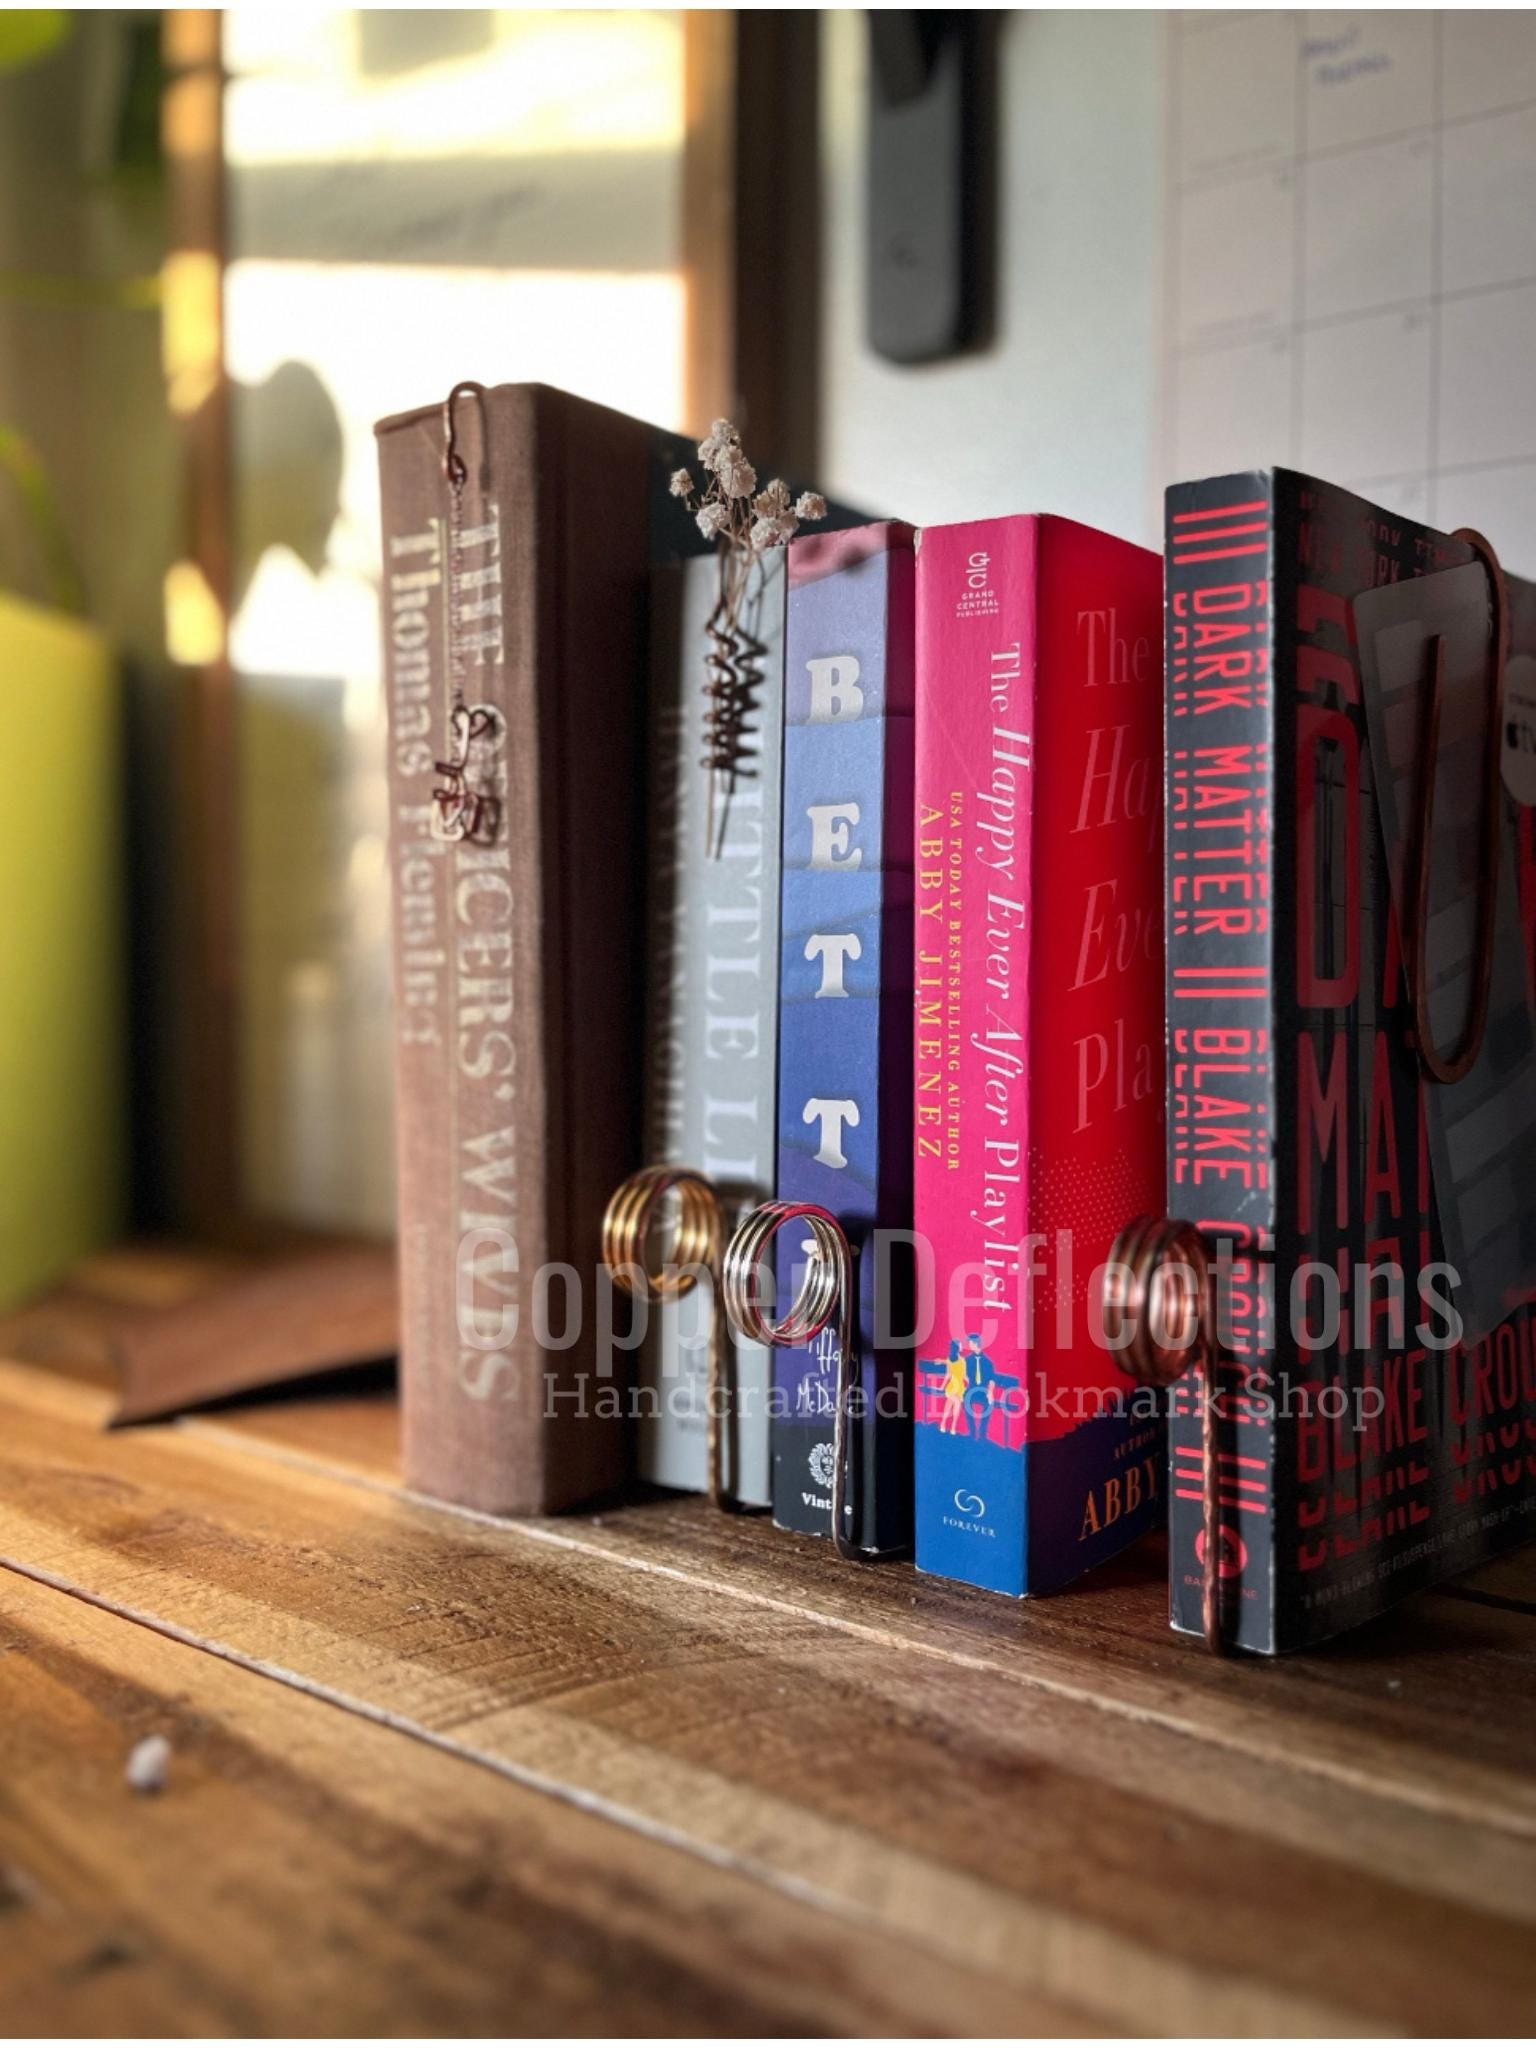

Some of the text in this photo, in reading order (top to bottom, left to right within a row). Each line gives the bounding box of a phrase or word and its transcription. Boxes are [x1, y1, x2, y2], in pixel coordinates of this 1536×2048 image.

[388, 516, 444, 779] Thomas
[956, 598, 1000, 611] CENTRAL
[960, 589, 995, 601] GRAND
[1077, 608, 1151, 687] The
[1193, 582, 1252, 716] DARK
[453, 703, 520, 1101] OFICERS'
[704, 728, 763, 1061] ITTLE
[1193, 744, 1252, 936] MATTER
[917, 803, 943, 1159] ABBY JIMENEZ
[946, 790, 963, 1171] USA TODAY BESTSELLING AUTHOR
[970, 642, 1031, 1313] The Happy Ever After Playlist
[1193, 1027, 1252, 1190] BLAKE
[801, 1492, 853, 1516] Vinte
[943, 1515, 997, 1538] FOREVER
[1078, 1452, 1160, 1542] ABBY
